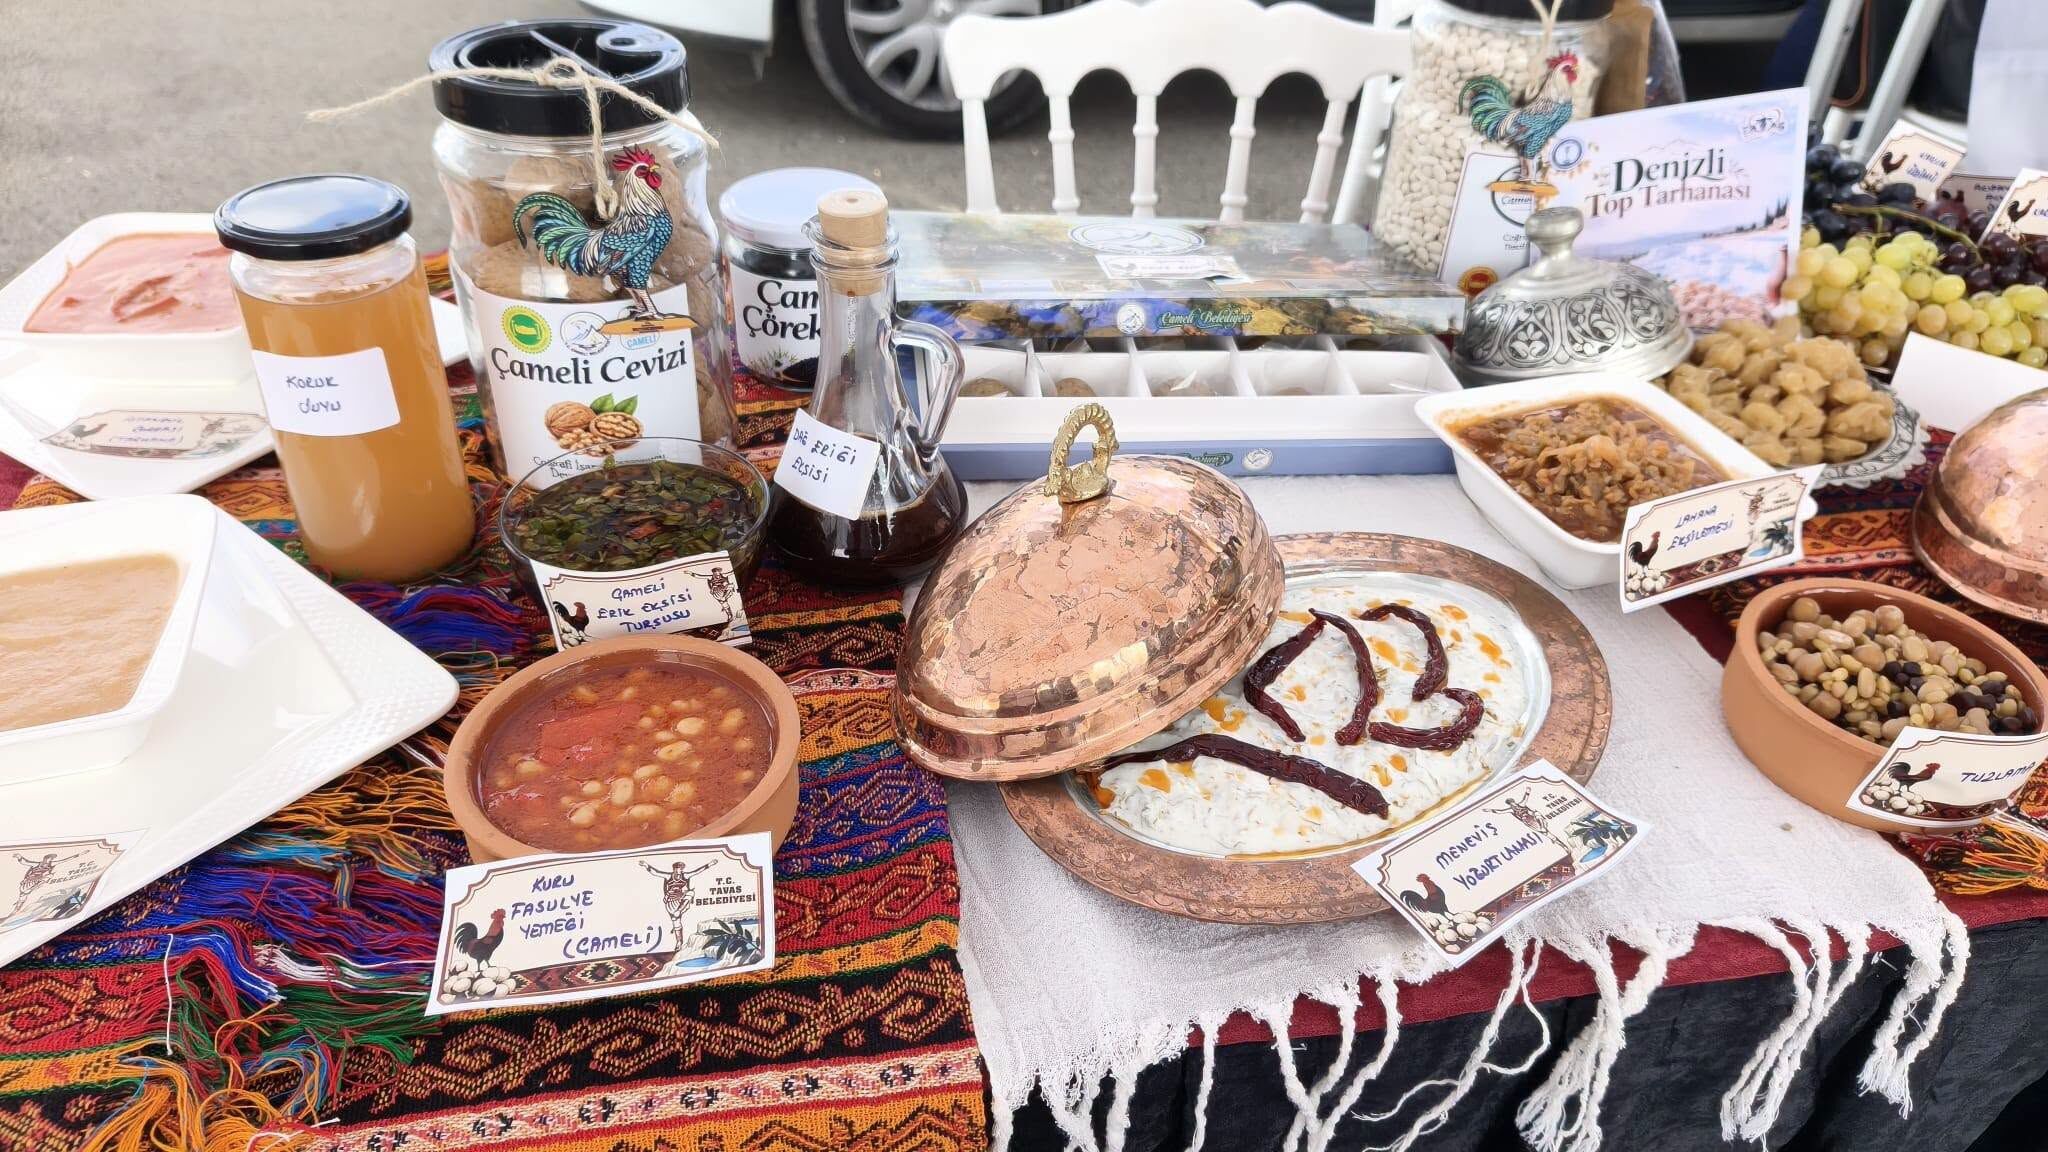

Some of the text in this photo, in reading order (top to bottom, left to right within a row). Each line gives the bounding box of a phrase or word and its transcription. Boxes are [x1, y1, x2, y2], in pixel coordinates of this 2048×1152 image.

[1613, 148, 1725, 193] Denizli
[1586, 182, 1751, 218] Top Tarhanası
[490, 340, 688, 385] Çameli Cevizi
[1675, 505, 1718, 529] LAHANA
[611, 577, 665, 601] ÇAMELİ
[619, 609, 691, 633] TURŞUSU
[1436, 822, 1498, 870] MENEVİŞ
[532, 874, 575, 893] KURU
[709, 885, 742, 895] TAVAS
[715, 877, 735, 886] T.C.
[511, 890, 594, 920] FASULYE
[695, 892, 756, 906] BELEDİYESİ
[520, 912, 584, 940] YEMEĞİ
